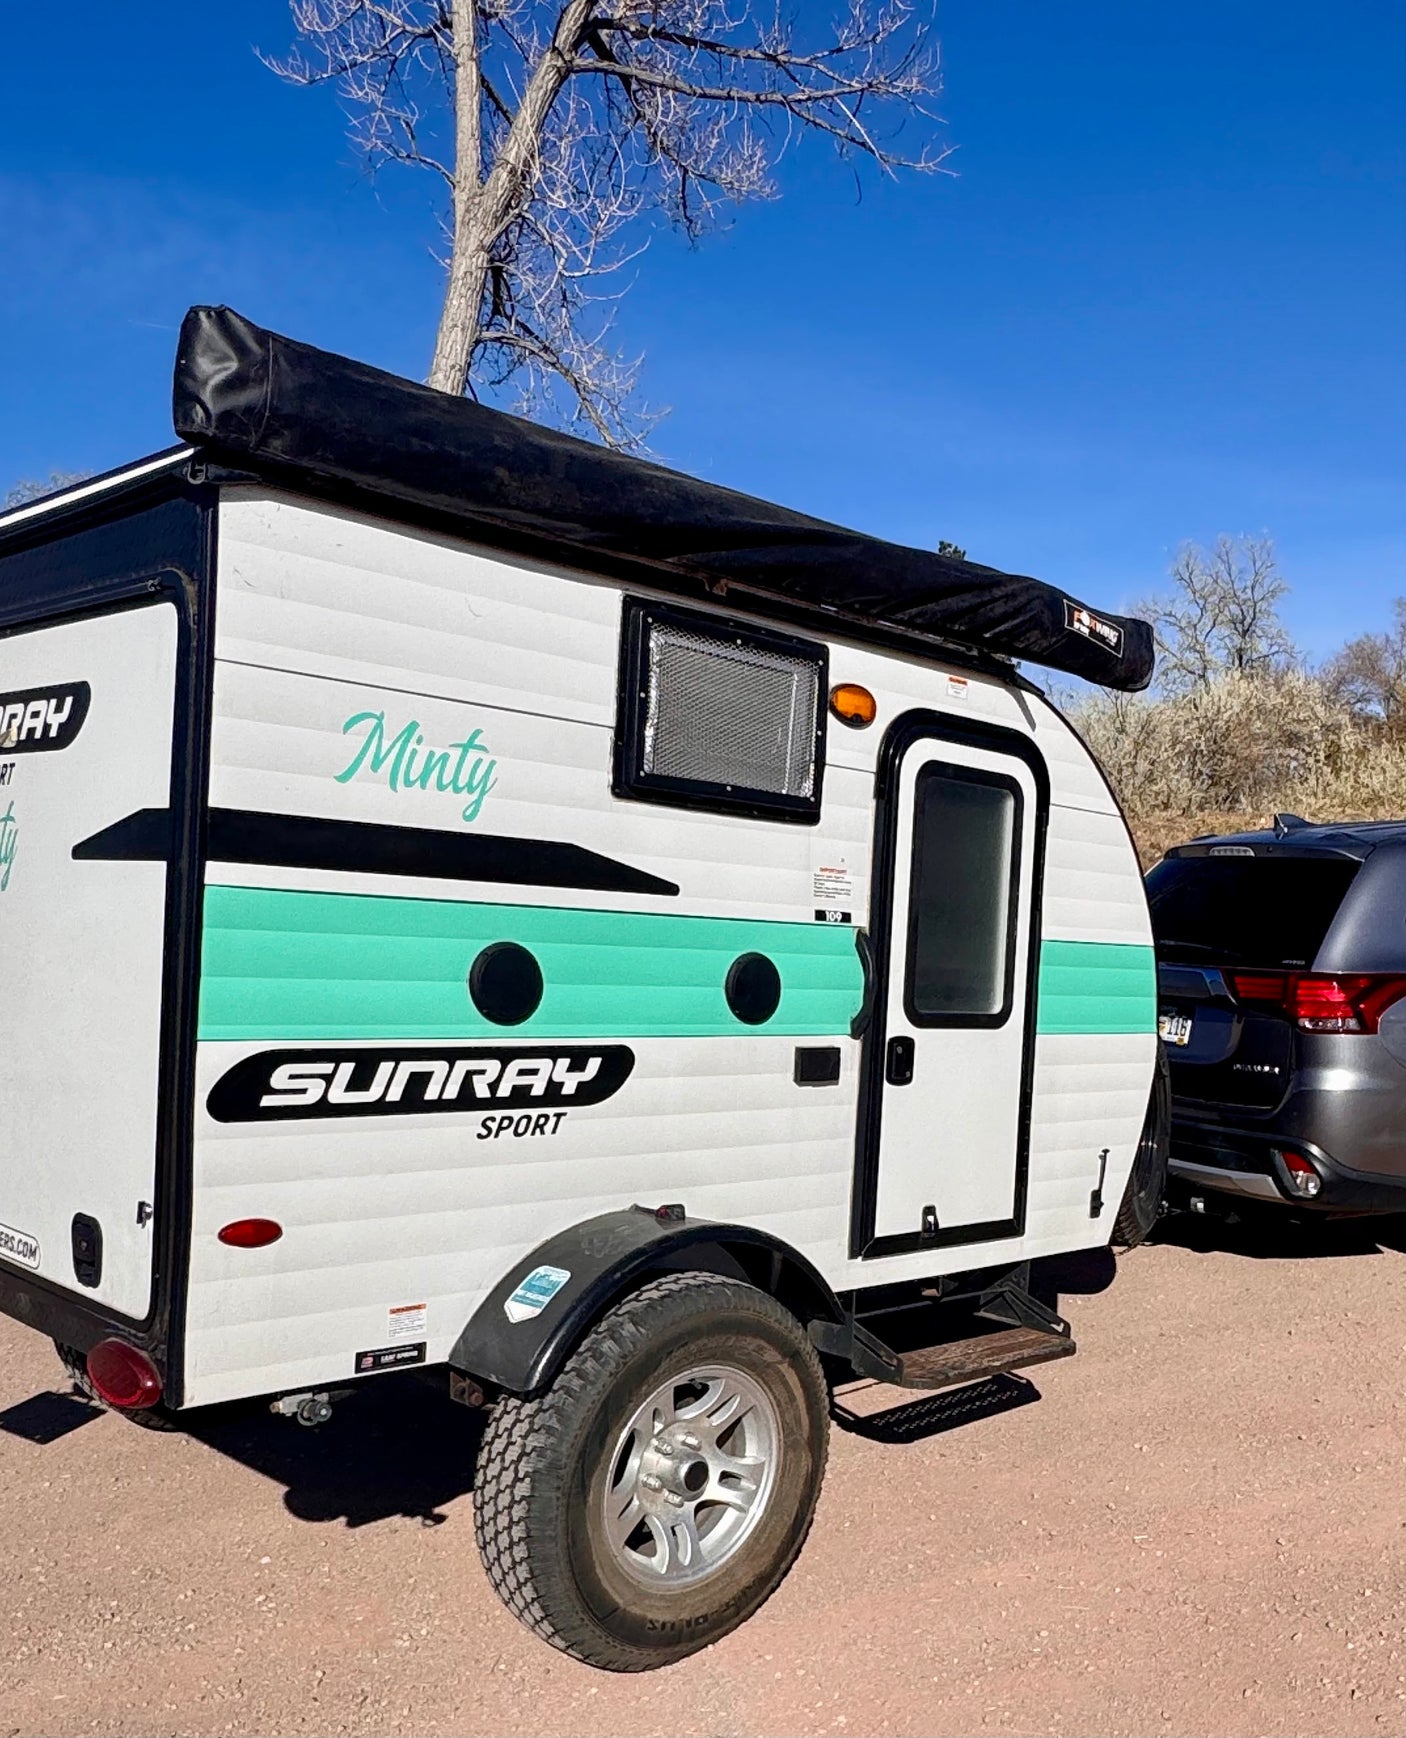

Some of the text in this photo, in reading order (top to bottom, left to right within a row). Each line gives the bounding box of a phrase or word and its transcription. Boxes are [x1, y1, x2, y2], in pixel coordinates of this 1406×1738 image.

[0, 696, 73, 741] RAY
[333, 710, 498, 822] Minty
[825, 910, 843, 922] 109
[260, 1057, 602, 1107] SUNRAY
[476, 1112, 567, 1140] SPORT
